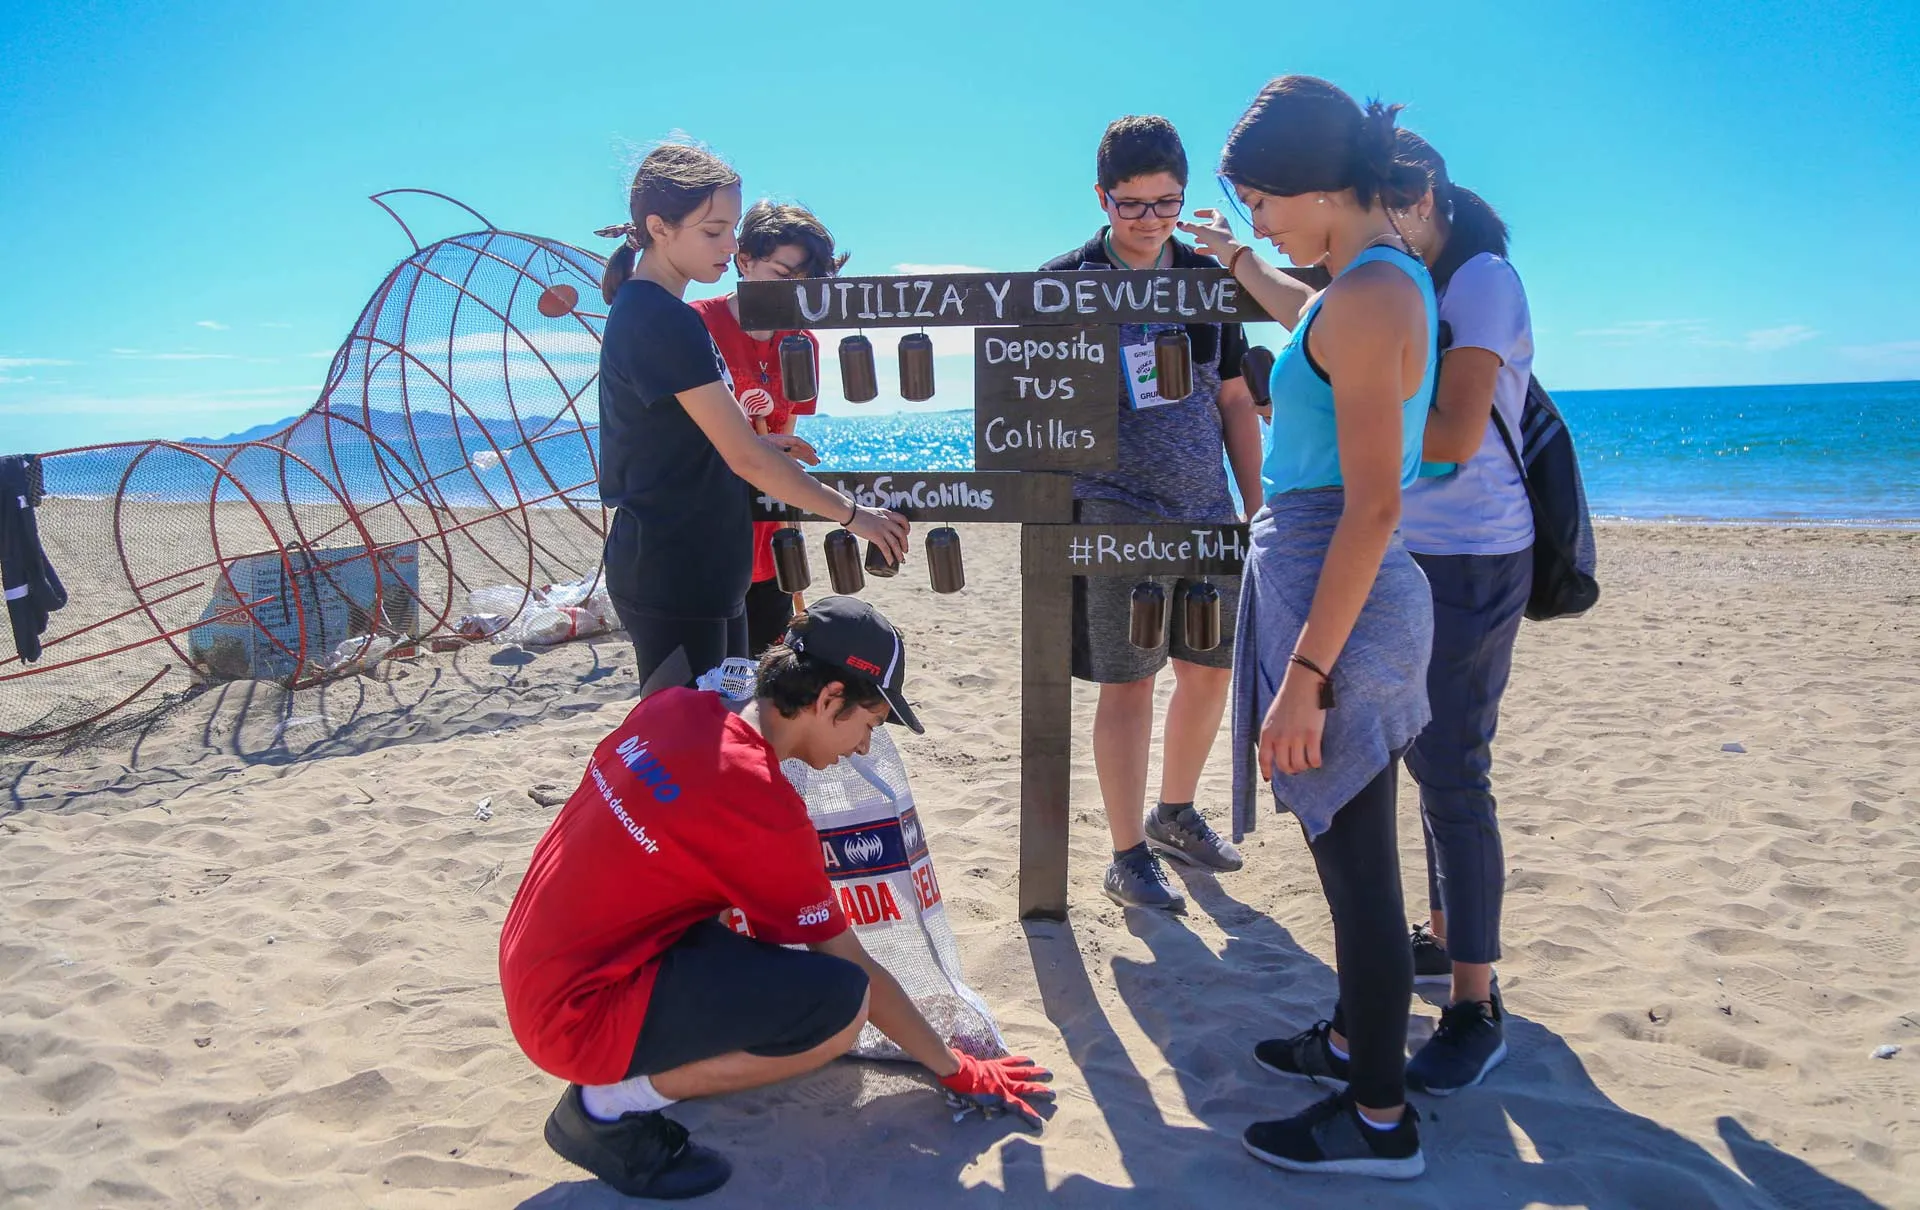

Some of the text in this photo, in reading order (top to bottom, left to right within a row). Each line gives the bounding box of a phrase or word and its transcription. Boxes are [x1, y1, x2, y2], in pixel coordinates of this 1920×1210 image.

[796, 276, 1238, 322] UTILIZA Y DEVUELVE
[985, 330, 1105, 370] Deposita
[1013, 376, 1075, 400] TUS
[985, 416, 1097, 455] Colillas
[846, 655, 881, 677] ESPN
[610, 798, 660, 854] descubrir
[797, 908, 830, 926] 2019
